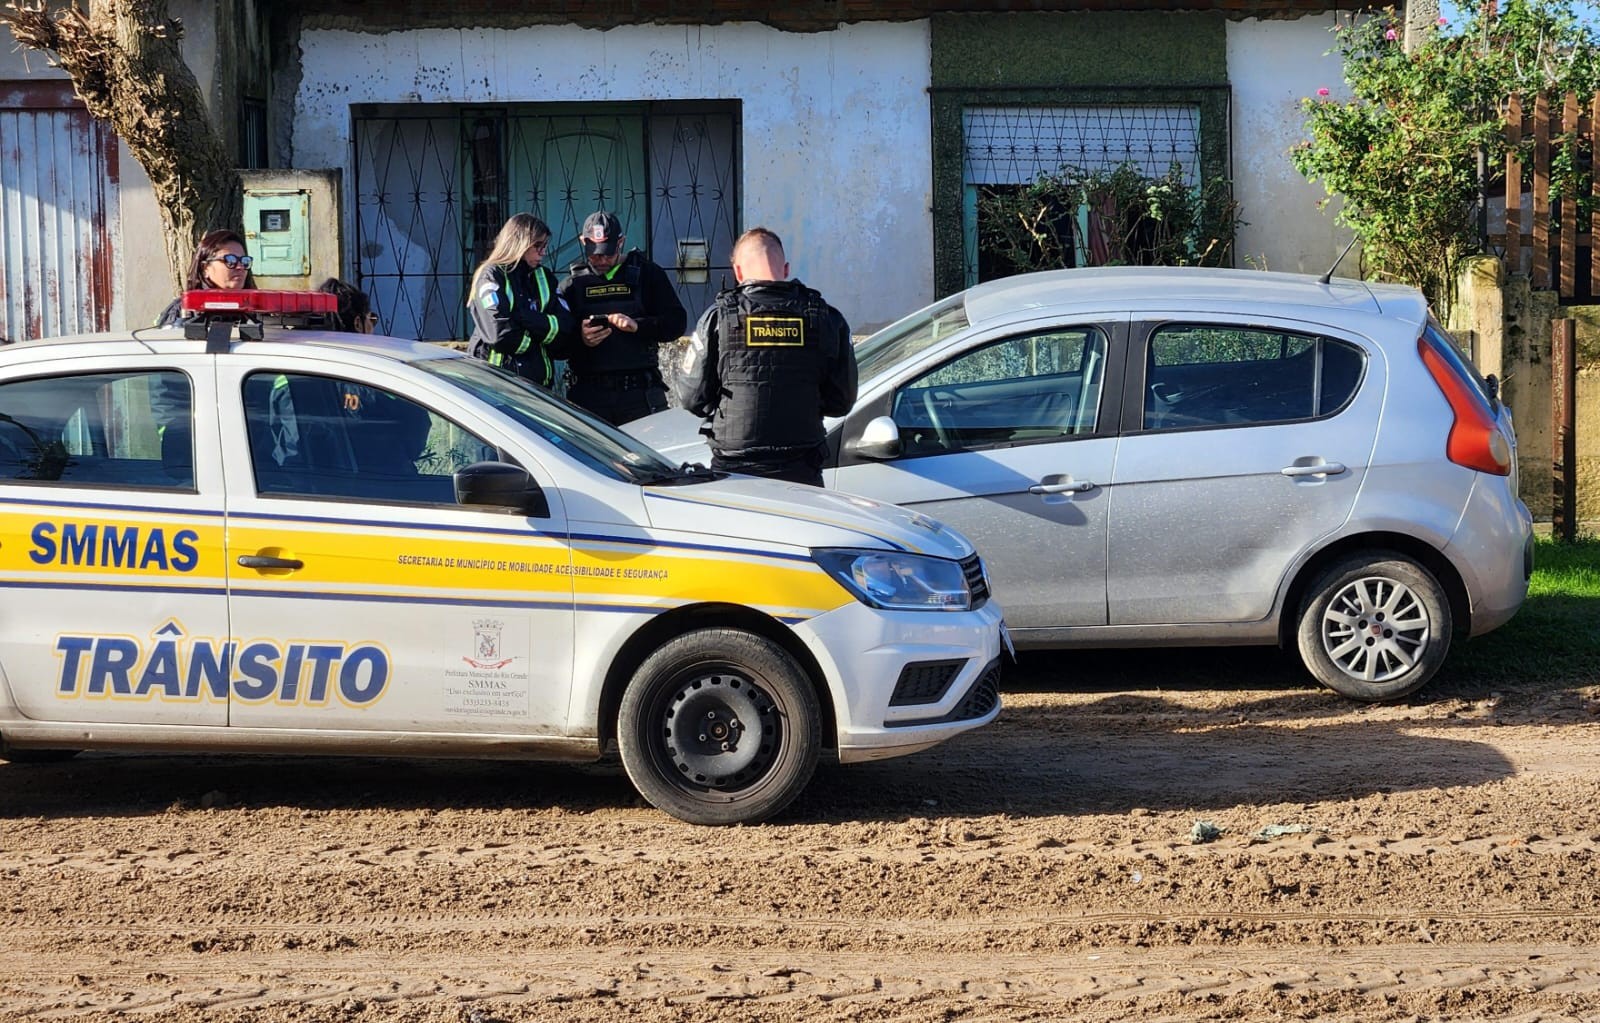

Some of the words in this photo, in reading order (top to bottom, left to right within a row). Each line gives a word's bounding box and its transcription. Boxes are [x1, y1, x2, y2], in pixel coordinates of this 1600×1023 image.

[29, 522, 199, 572] SMMAS
[398, 555, 443, 567] SECRETARIA
[445, 558, 454, 568] DE
[497, 561, 507, 571] DE
[509, 561, 553, 574] MOBILIDADE
[555, 564, 615, 578] ACESSIBILIDADE
[616, 568, 621, 578] E
[623, 569, 669, 582] SEGURANÇA
[56, 621, 389, 703] TRÂNSITO
[468, 680, 507, 689] SMMAS
